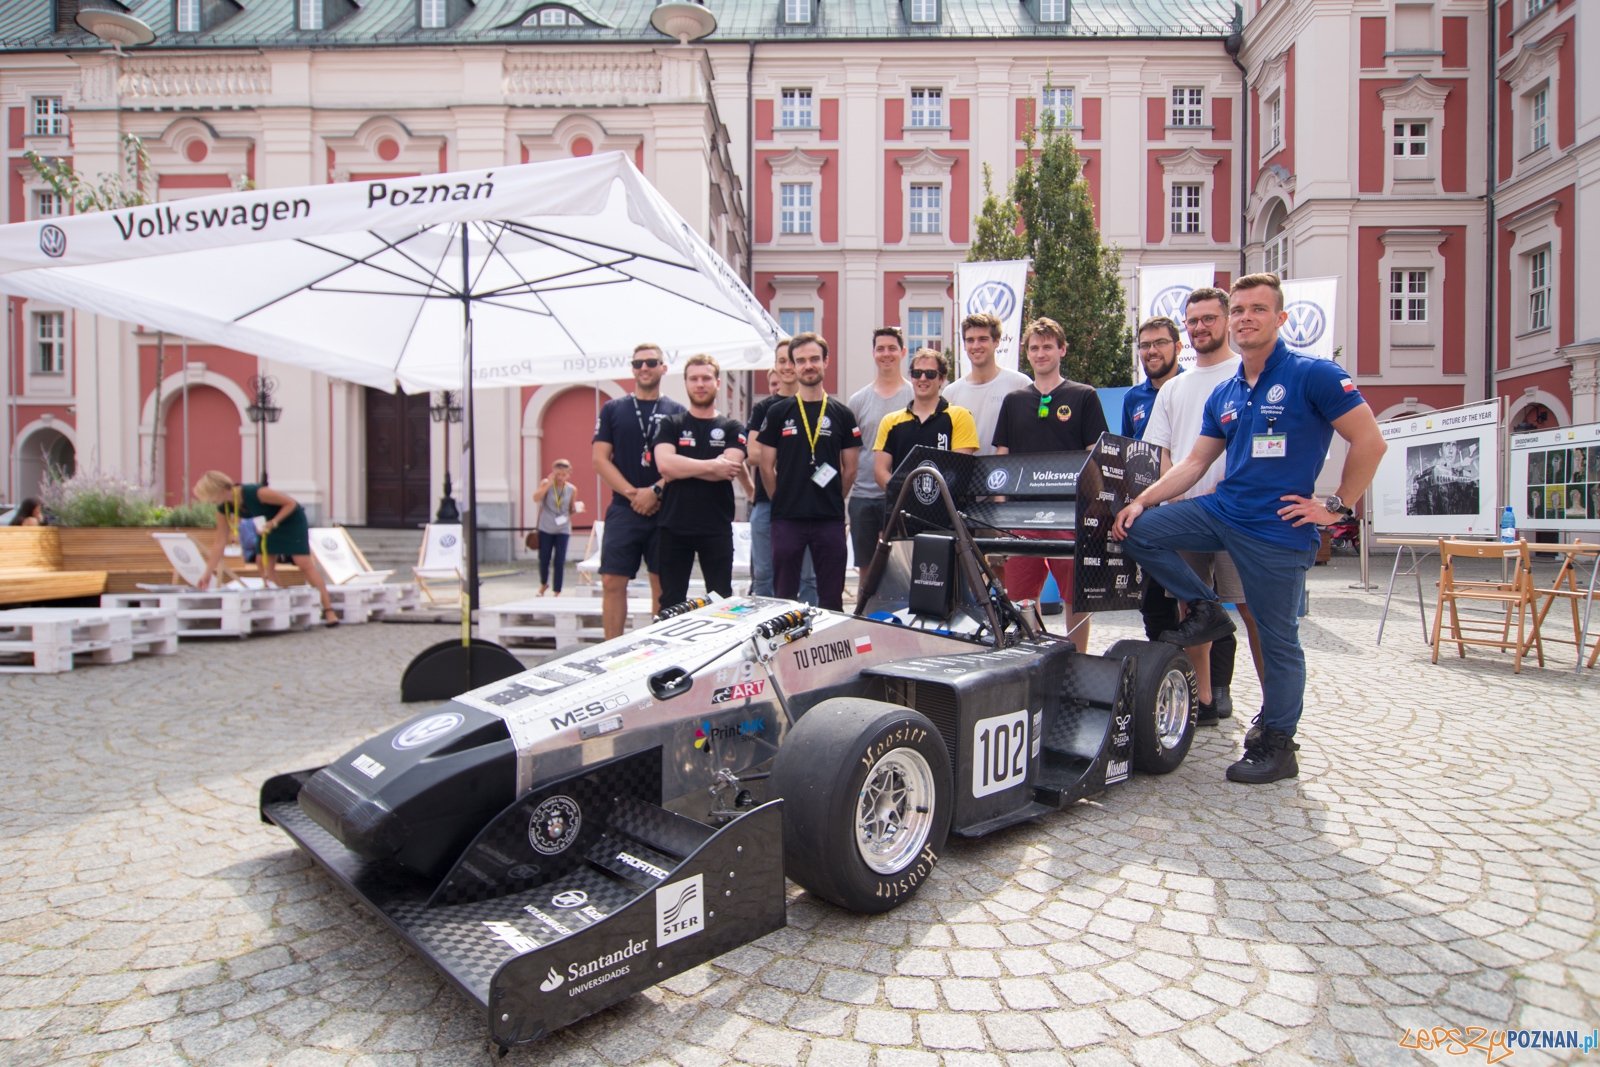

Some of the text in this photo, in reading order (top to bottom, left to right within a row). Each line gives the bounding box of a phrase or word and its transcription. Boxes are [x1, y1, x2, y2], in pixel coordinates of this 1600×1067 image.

[114, 172, 495, 240] Volkswagen Poznań
[1442, 416, 1460, 426] PICTURE
[1468, 413, 1478, 421] THE
[1479, 411, 1492, 420] YEAR
[1390, 427, 1401, 435] ROKU
[1109, 467, 1124, 476] TUBES
[1084, 517, 1099, 527] LORD
[1083, 557, 1101, 566] MAHLE
[1108, 558, 1124, 567] MOTUL
[914, 579, 945, 587] MOTORSPORT
[648, 618, 735, 642] 102
[793, 639, 853, 670] TU POZNAN
[550, 693, 630, 730] MESCO
[861, 720, 927, 776] Hoosier
[979, 719, 1026, 788] 102
[876, 843, 938, 903] Hoosier
[663, 915, 699, 937] STER
[567, 938, 649, 982] Santander
[568, 964, 631, 997] UNIVERSIDADES
